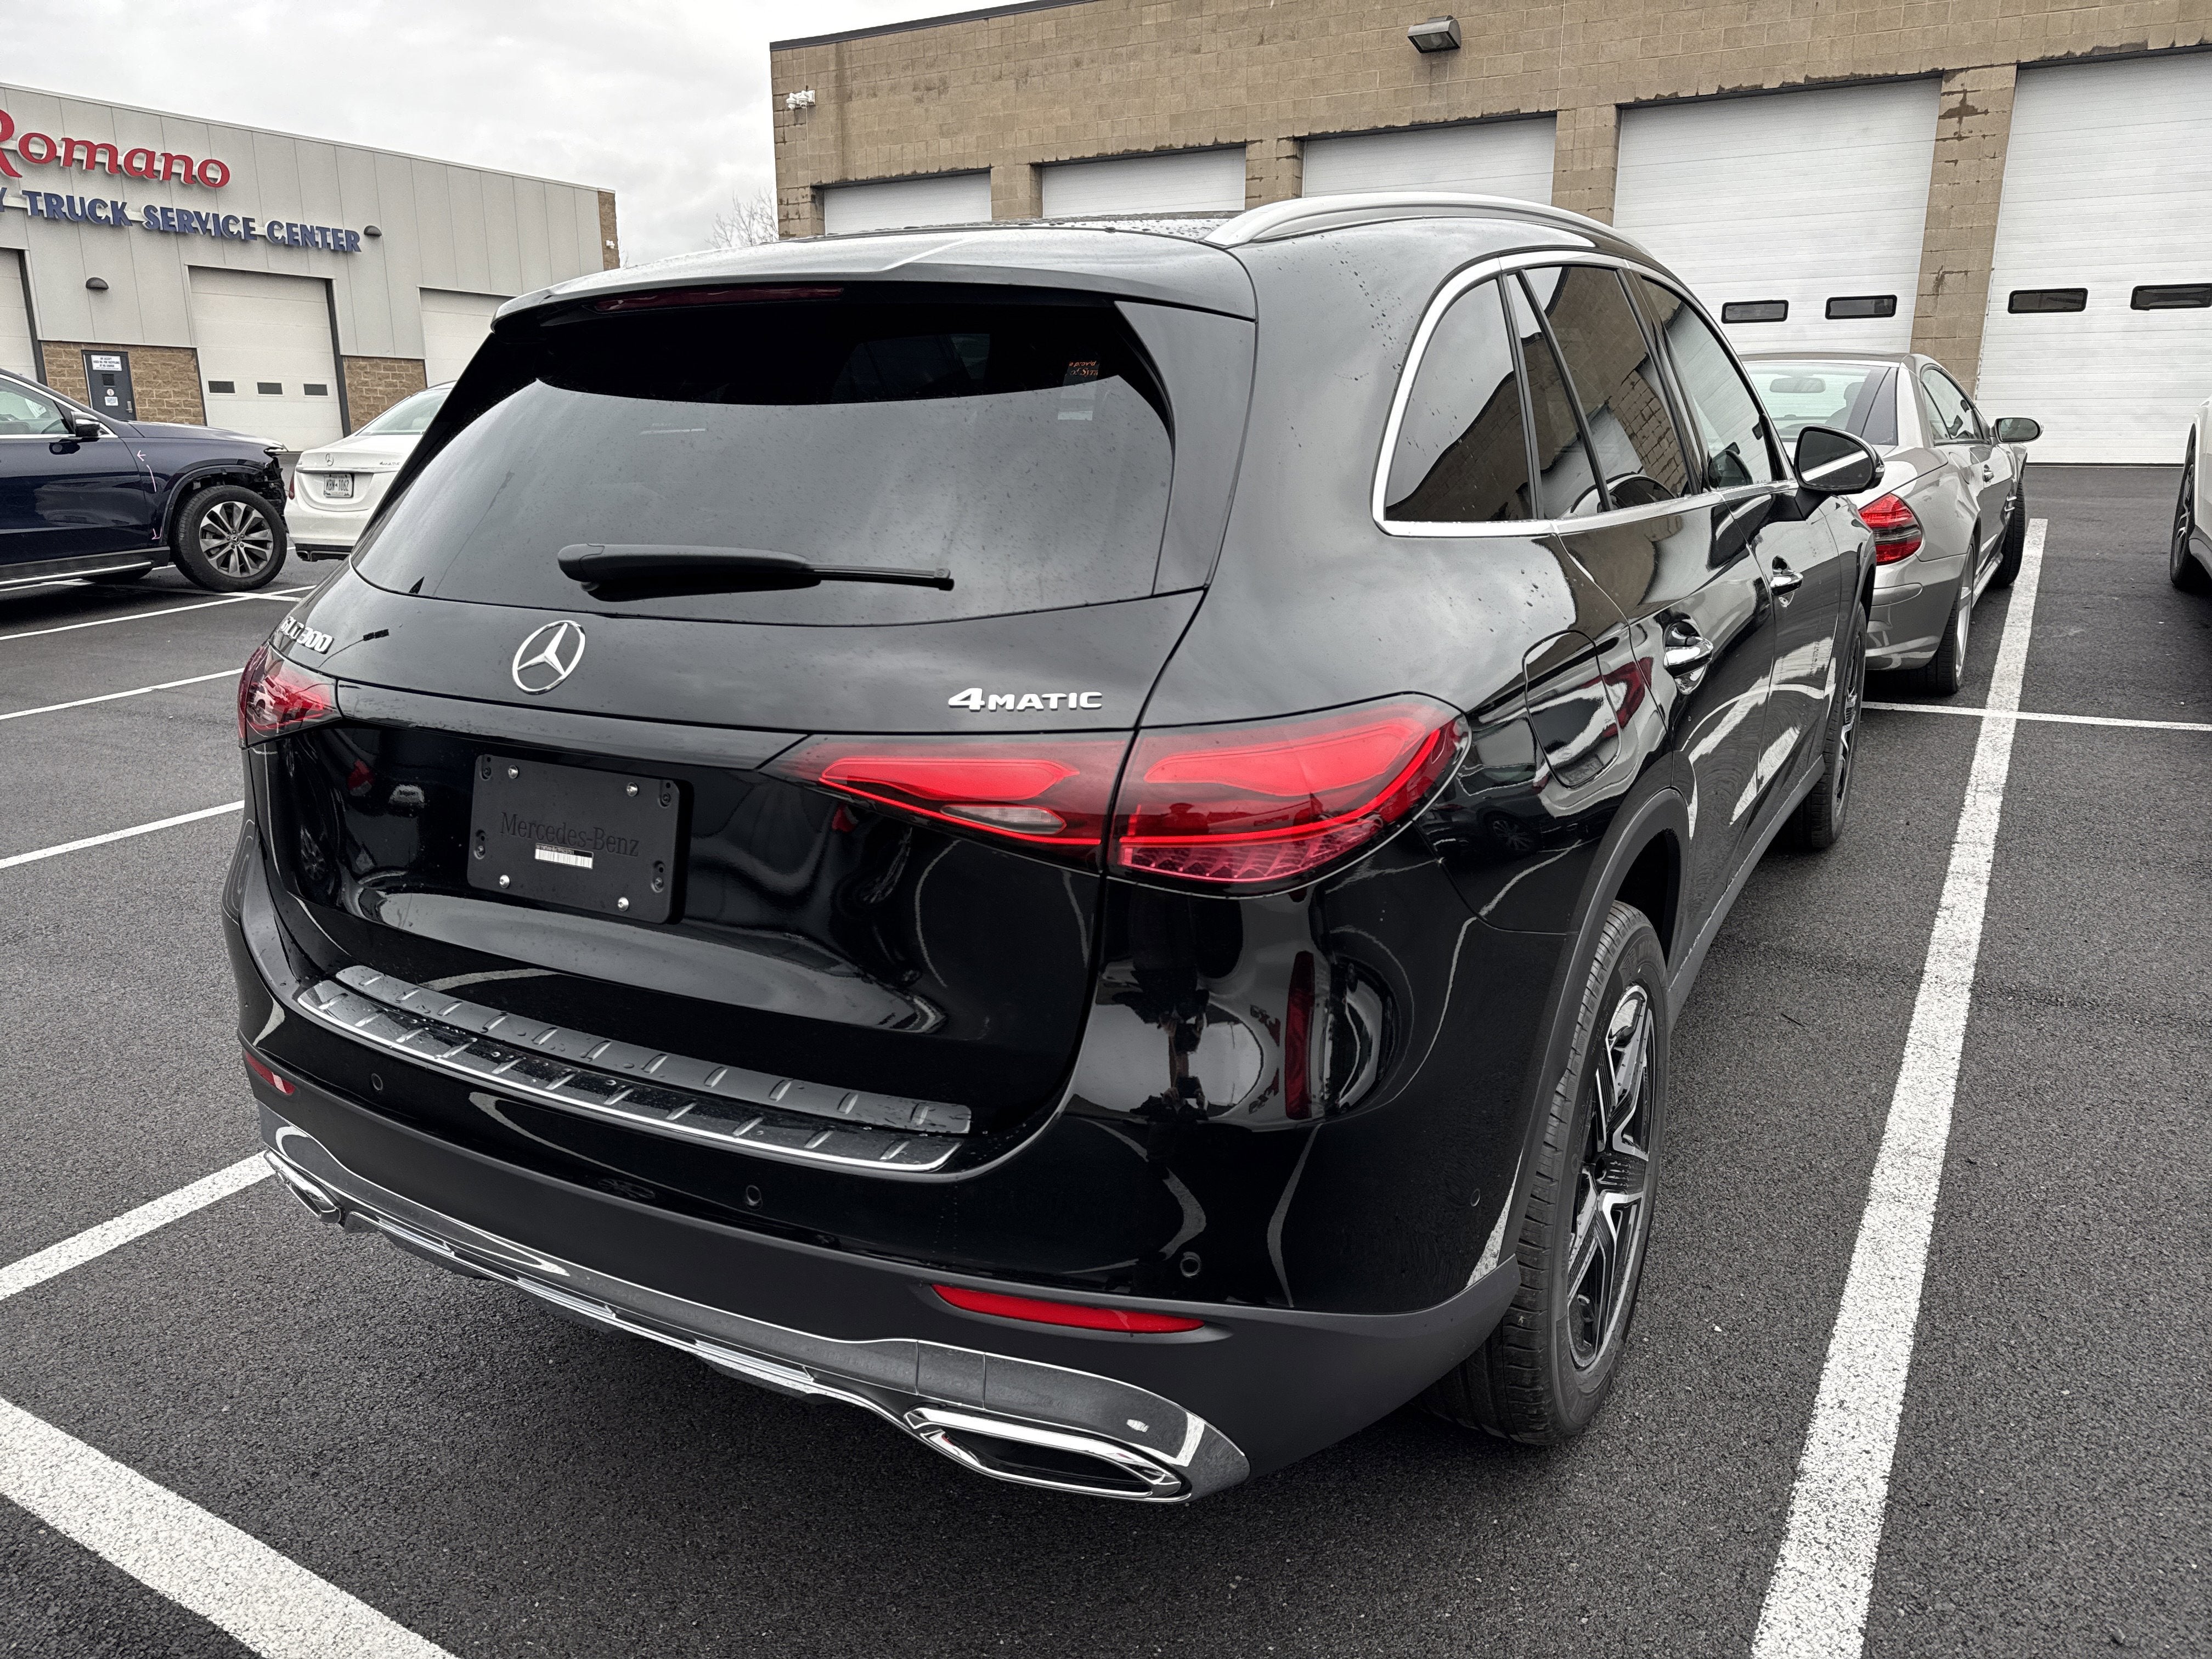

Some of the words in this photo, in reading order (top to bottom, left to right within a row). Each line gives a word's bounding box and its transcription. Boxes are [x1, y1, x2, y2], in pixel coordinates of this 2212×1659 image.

[20, 189, 133, 227] TRUCK
[142, 204, 257, 241] SERVICE
[265, 220, 362, 252] CENTER
[296, 627, 333, 653] 300
[948, 687, 1102, 710] 4MATIC
[500, 812, 640, 857] Mercedes-Benz
